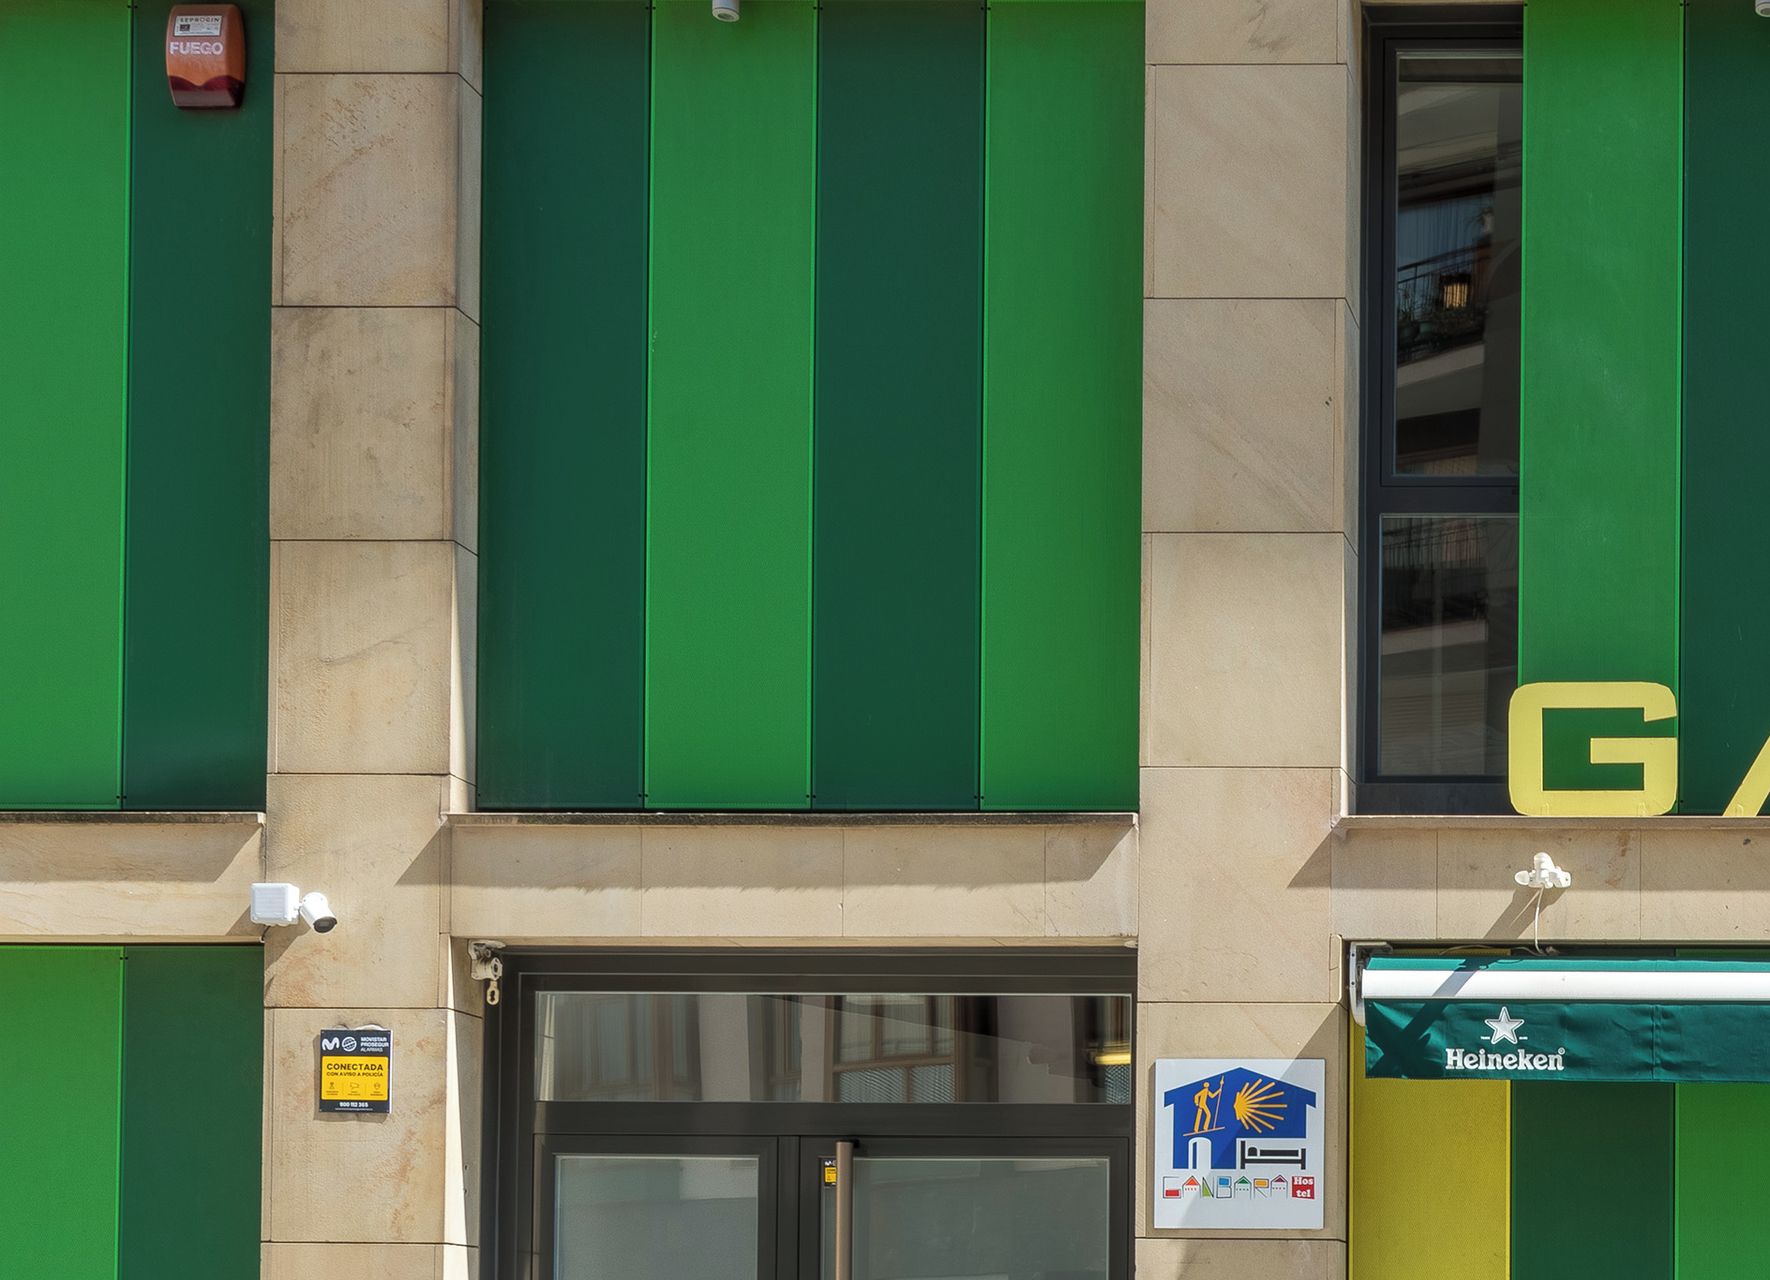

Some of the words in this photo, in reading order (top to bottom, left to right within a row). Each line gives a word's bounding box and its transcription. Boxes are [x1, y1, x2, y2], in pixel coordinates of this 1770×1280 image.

[169, 41, 224, 55] FUEGO
[326, 1063, 384, 1071] CONECTADA
[1293, 1176, 1314, 1185] Hos
[1162, 1174, 1289, 1199] GANBARA
[1296, 1188, 1311, 1198] tel
